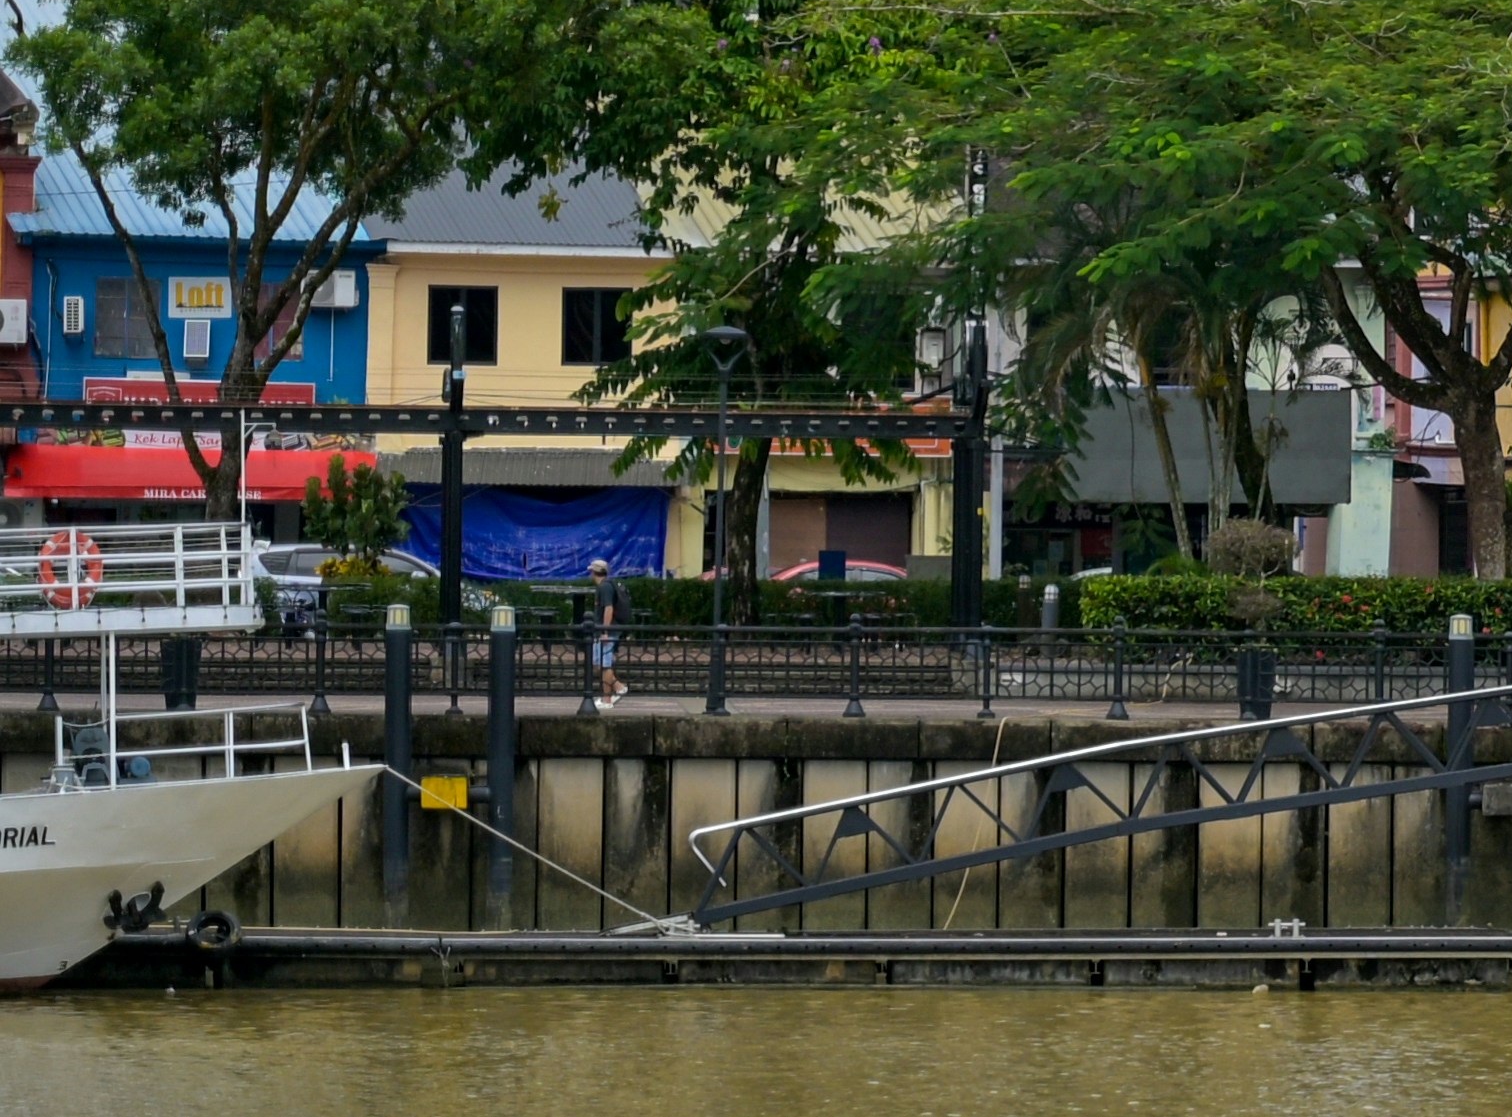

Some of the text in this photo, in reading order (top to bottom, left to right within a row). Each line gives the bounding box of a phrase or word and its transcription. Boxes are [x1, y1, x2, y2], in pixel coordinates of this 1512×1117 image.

[175, 281, 224, 308] Loft
[143, 489, 178, 499] MIRA
[180, 489, 208, 499] CAK
[0, 826, 56, 849] RIAL
